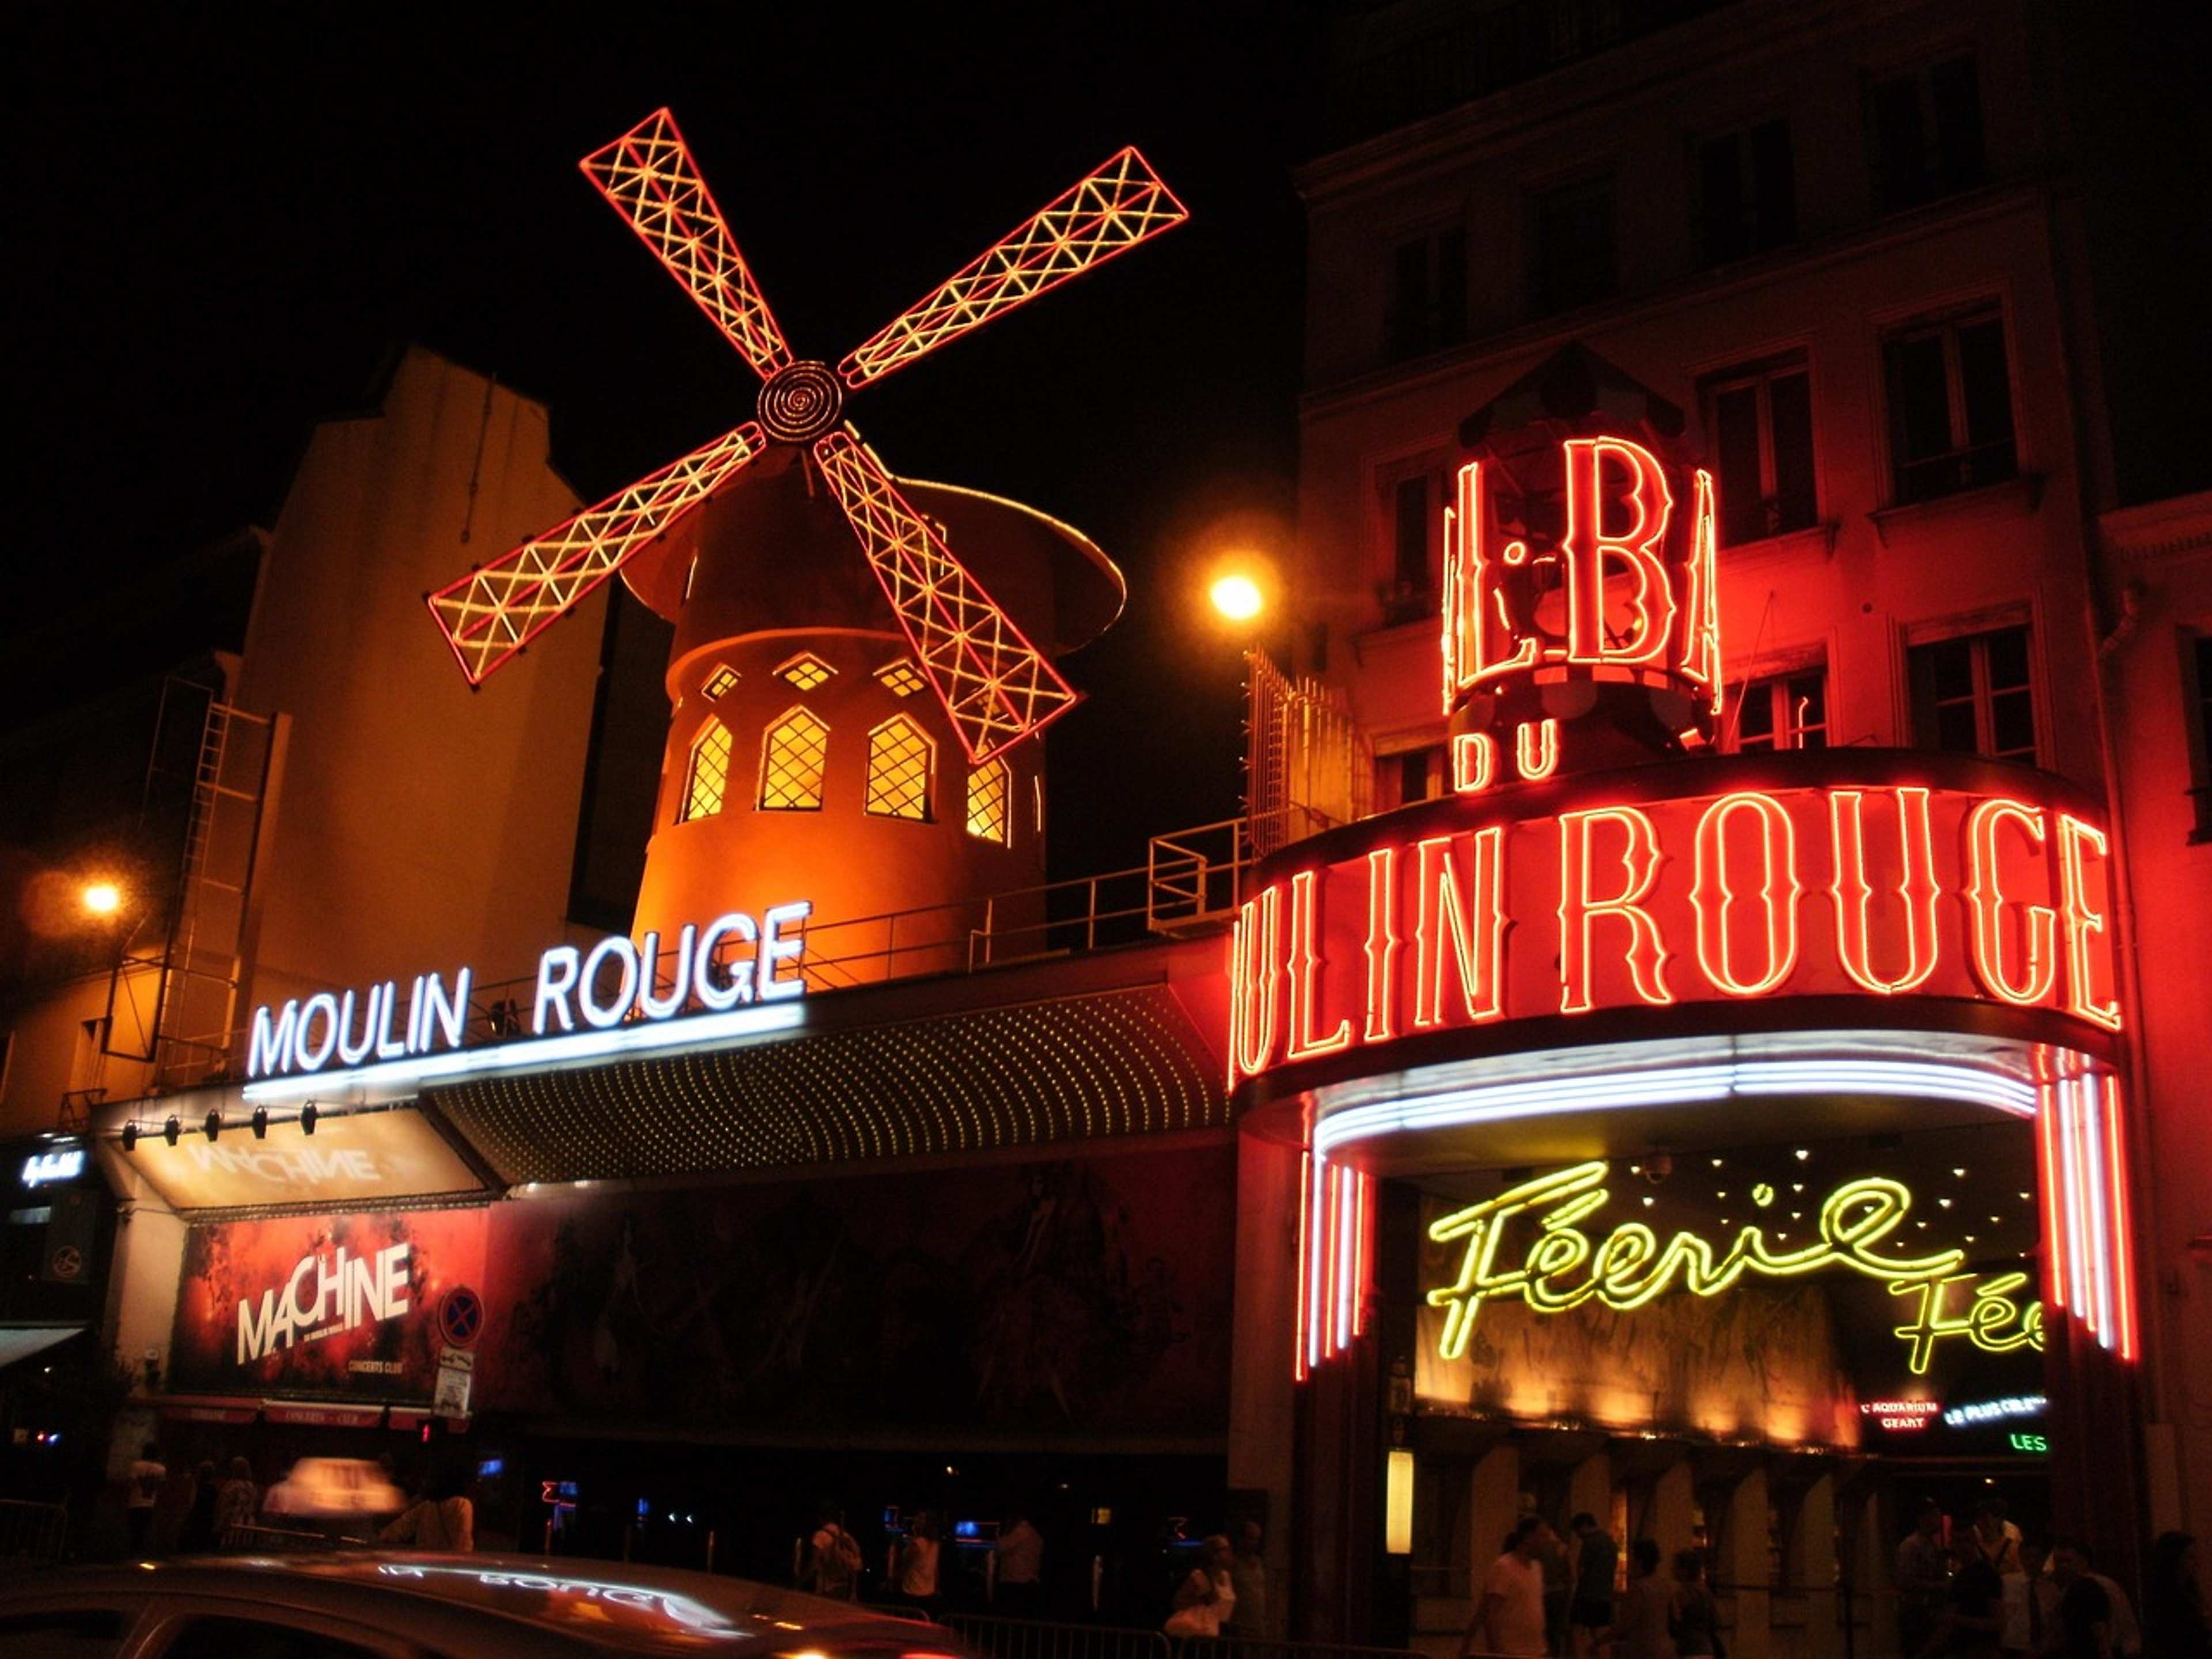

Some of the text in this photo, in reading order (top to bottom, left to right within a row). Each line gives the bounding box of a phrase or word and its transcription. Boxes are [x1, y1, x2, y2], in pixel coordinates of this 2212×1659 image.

[1453, 718, 1556, 792] DU
[247, 900, 813, 1080] MOULIN ROUGE
[1228, 787, 2122, 1092] ULIN ROUGE
[237, 1242, 409, 1366] MACHINE
[1427, 1161, 1964, 1360] Féerie
[2010, 1433, 2047, 1451] LES
